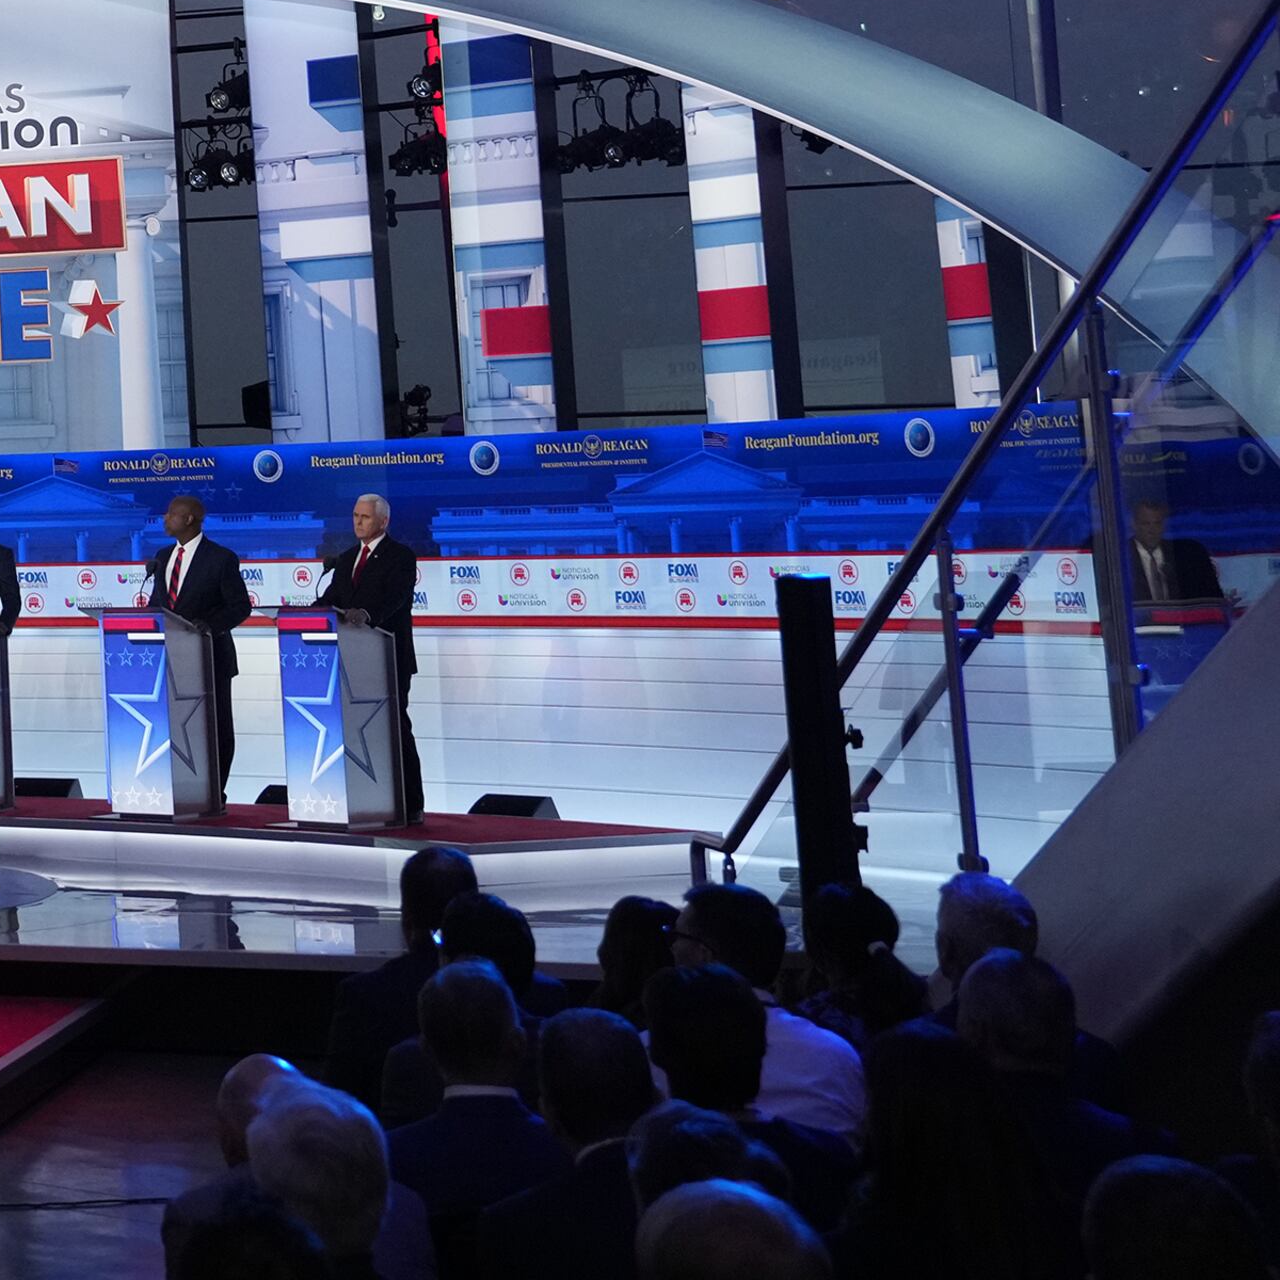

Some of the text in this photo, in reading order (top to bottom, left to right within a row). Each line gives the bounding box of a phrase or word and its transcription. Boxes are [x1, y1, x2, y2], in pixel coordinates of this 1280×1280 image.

[535, 439, 649, 455] RONALD REAGAN
[745, 430, 879, 451] ReaganFoundation.org
[103, 457, 215, 471] RONALD REAGAN
[311, 451, 444, 468] ReaganFoundation.org
[240, 569, 263, 581] OX
[450, 566, 480, 578] FOX
[668, 564, 698, 577] FOX
[18, 572, 48, 584] FOX
[615, 590, 646, 604] FOX
[835, 590, 866, 605] FOX
[1054, 592, 1086, 607] FOX
